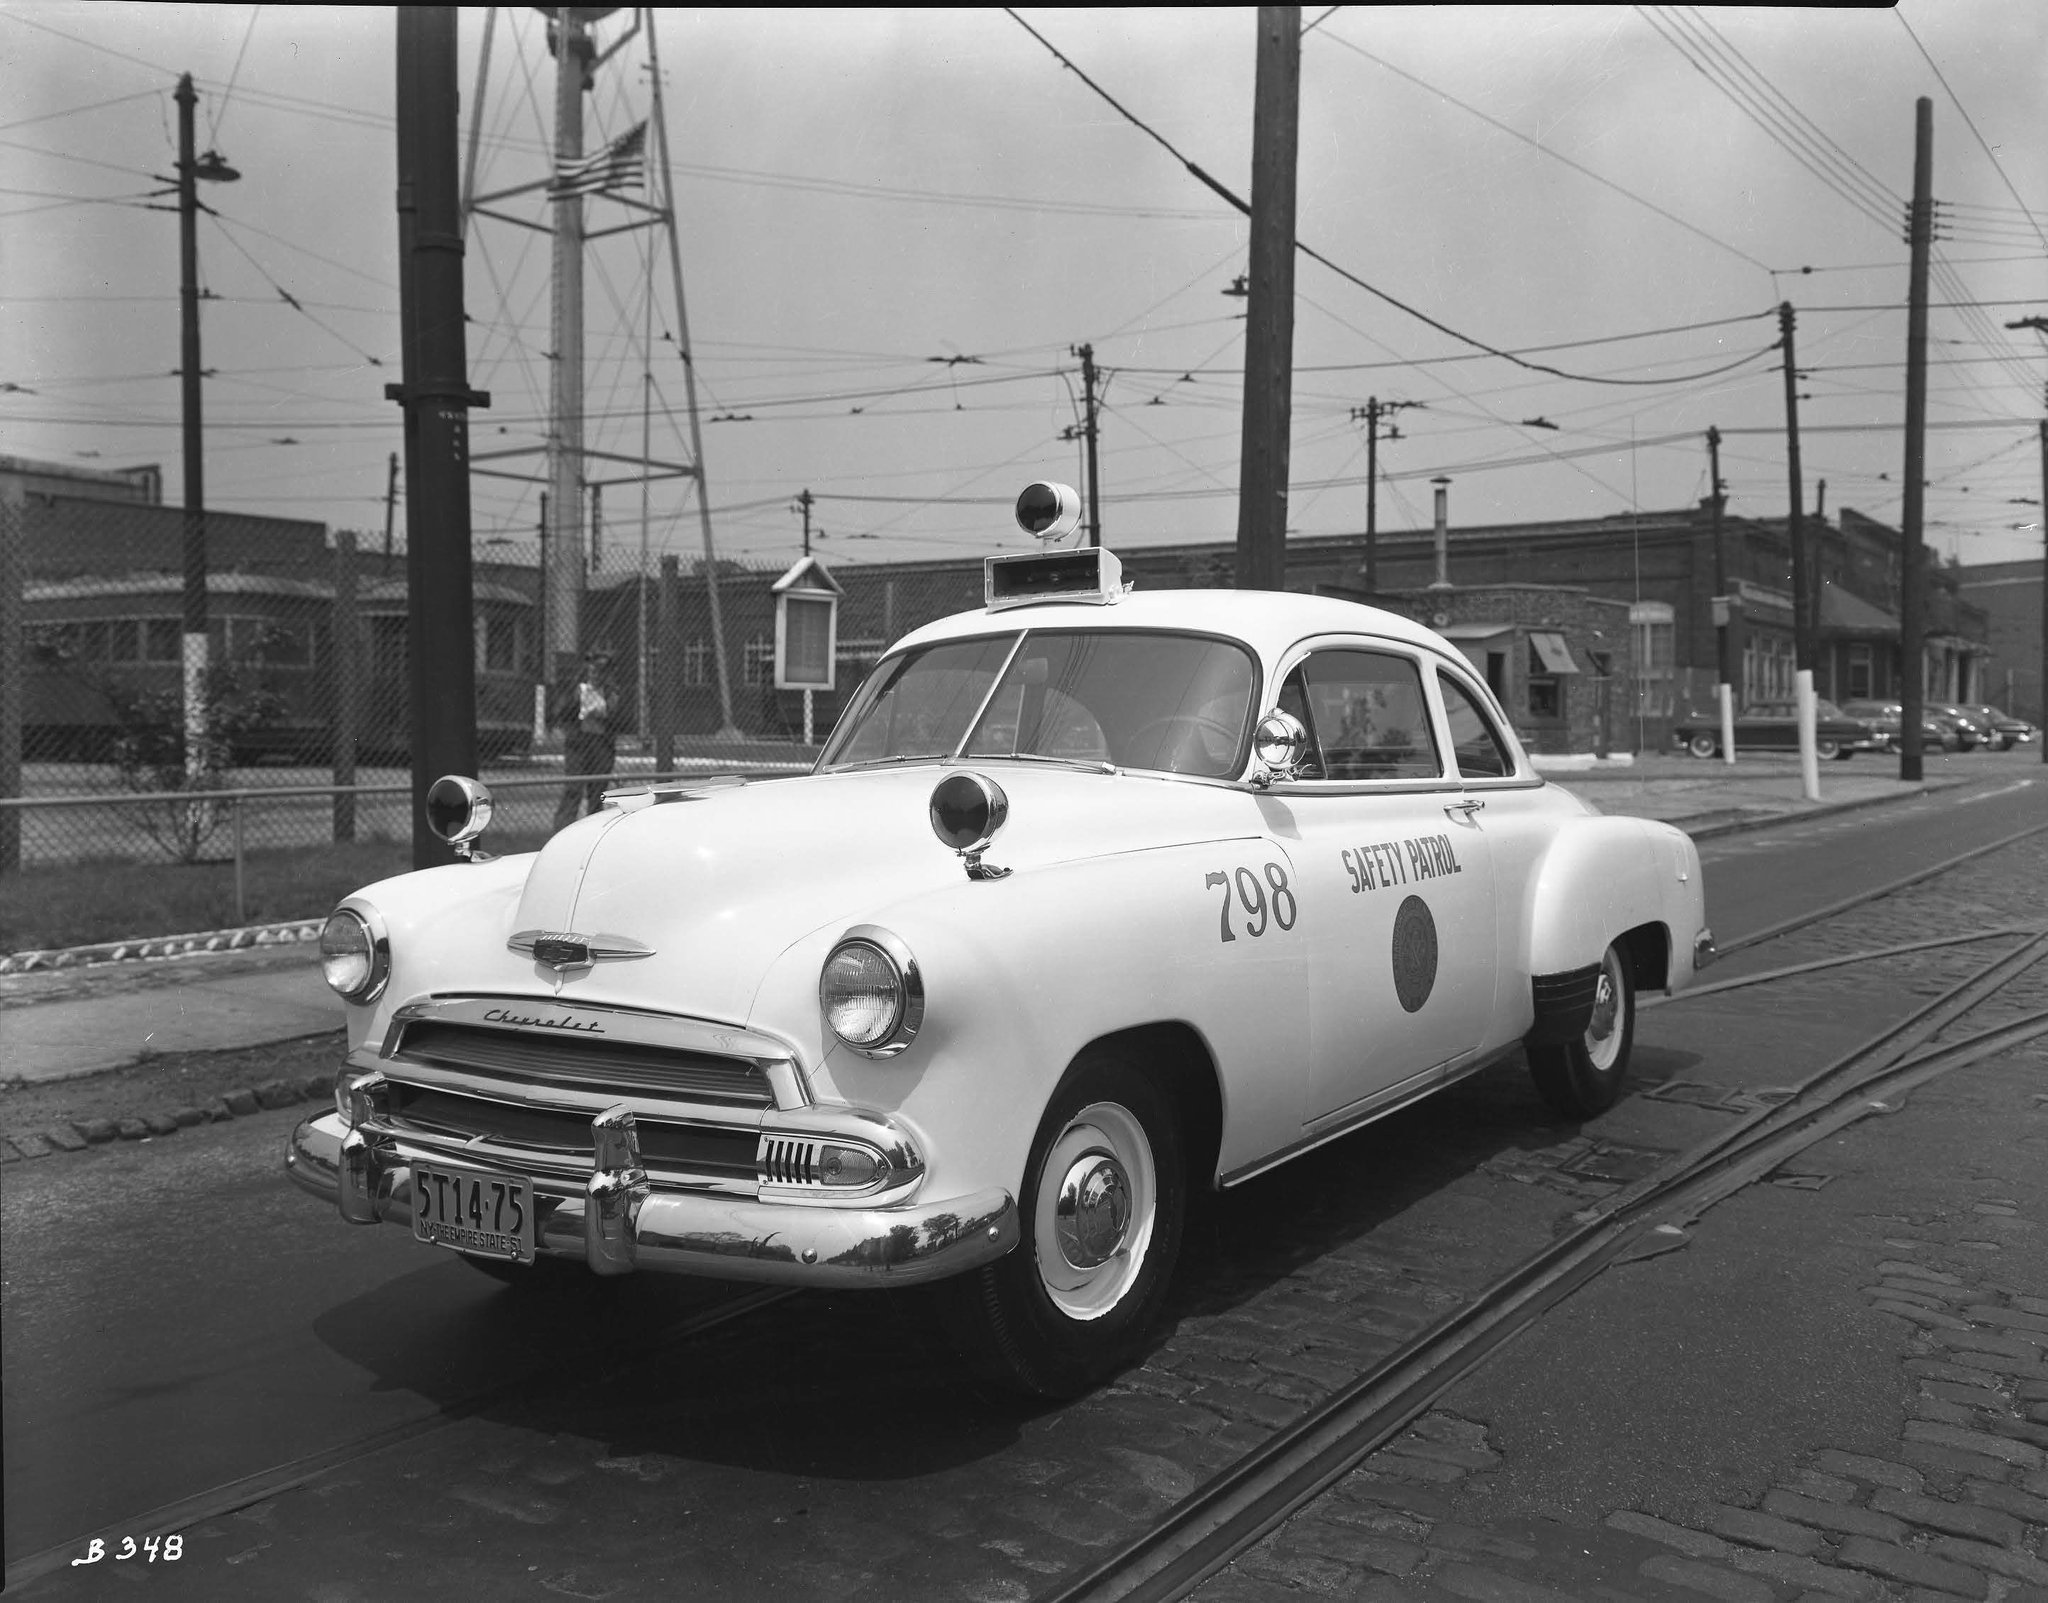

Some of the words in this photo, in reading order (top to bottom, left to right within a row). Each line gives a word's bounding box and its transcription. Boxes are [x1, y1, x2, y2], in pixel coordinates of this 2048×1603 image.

[1341, 841, 1407, 894] SAFETY
[1403, 833, 1462, 882] PATROL
[1205, 862, 1297, 943] 798
[483, 1009, 605, 1033] Chevrolet
[449, 1226, 479, 1248] EMPIRE
